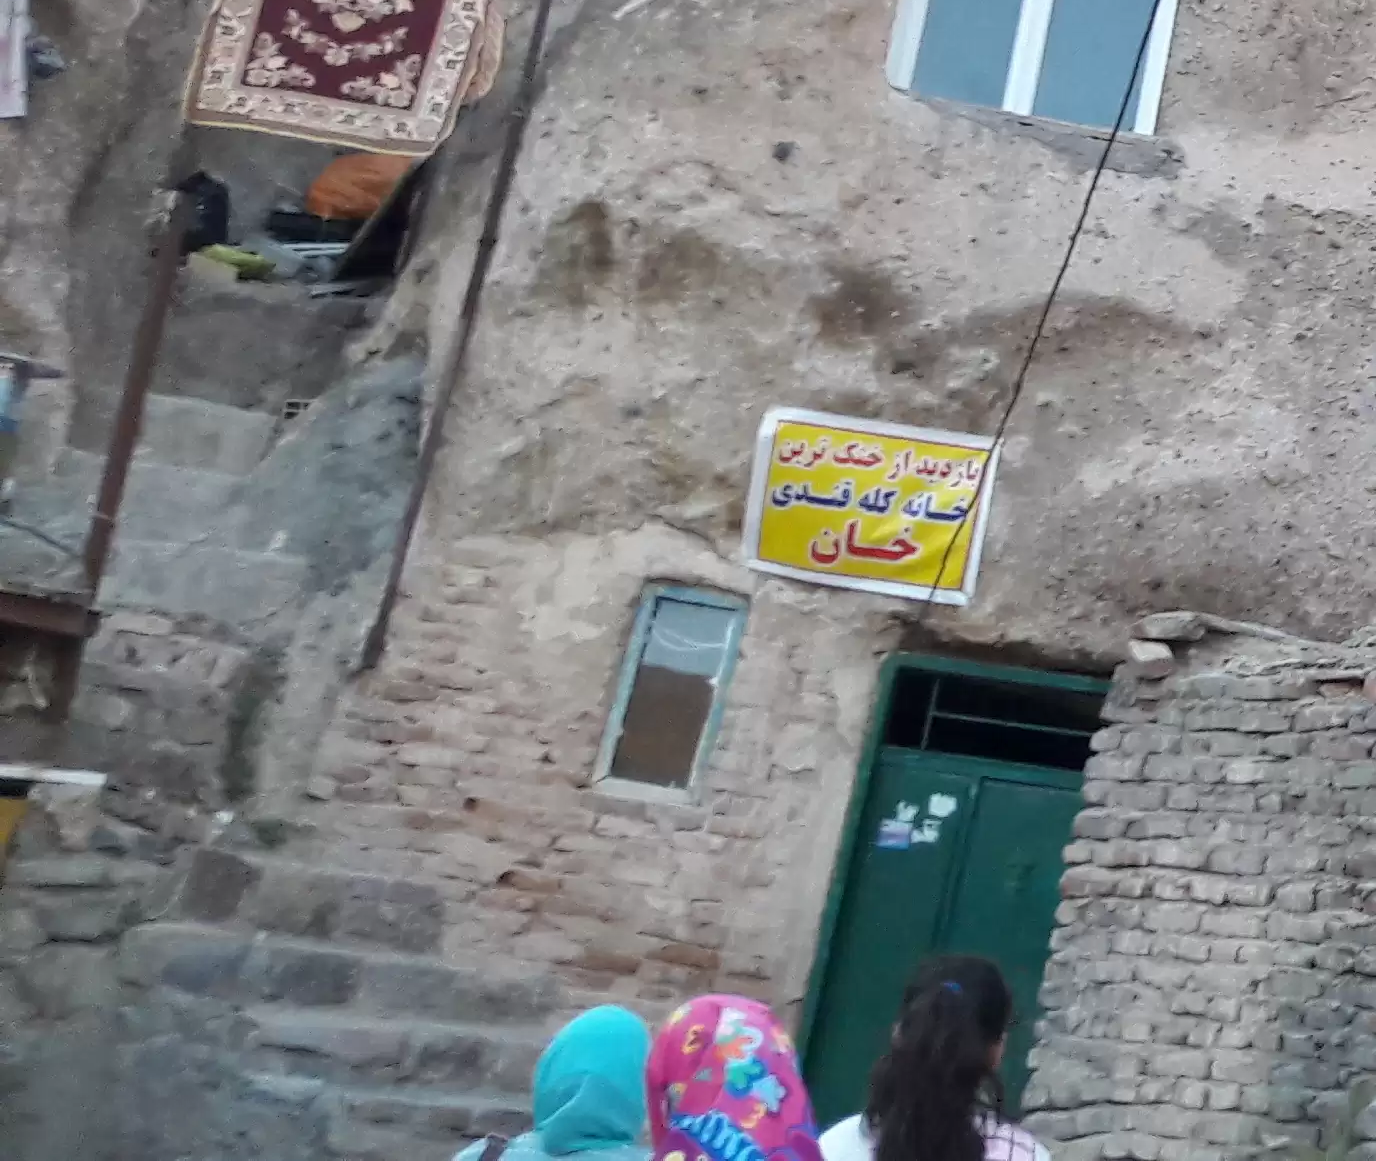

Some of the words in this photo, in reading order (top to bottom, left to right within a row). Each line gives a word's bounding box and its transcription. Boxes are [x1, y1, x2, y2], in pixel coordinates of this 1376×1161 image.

[779, 438, 828, 468] ترین
[833, 442, 884, 466] خنک
[888, 450, 912, 480] از
[915, 458, 980, 488] بازدید
[771, 480, 853, 508] قندی
[858, 487, 898, 514] کله
[902, 491, 968, 522] خانه
[810, 519, 920, 564] خان
